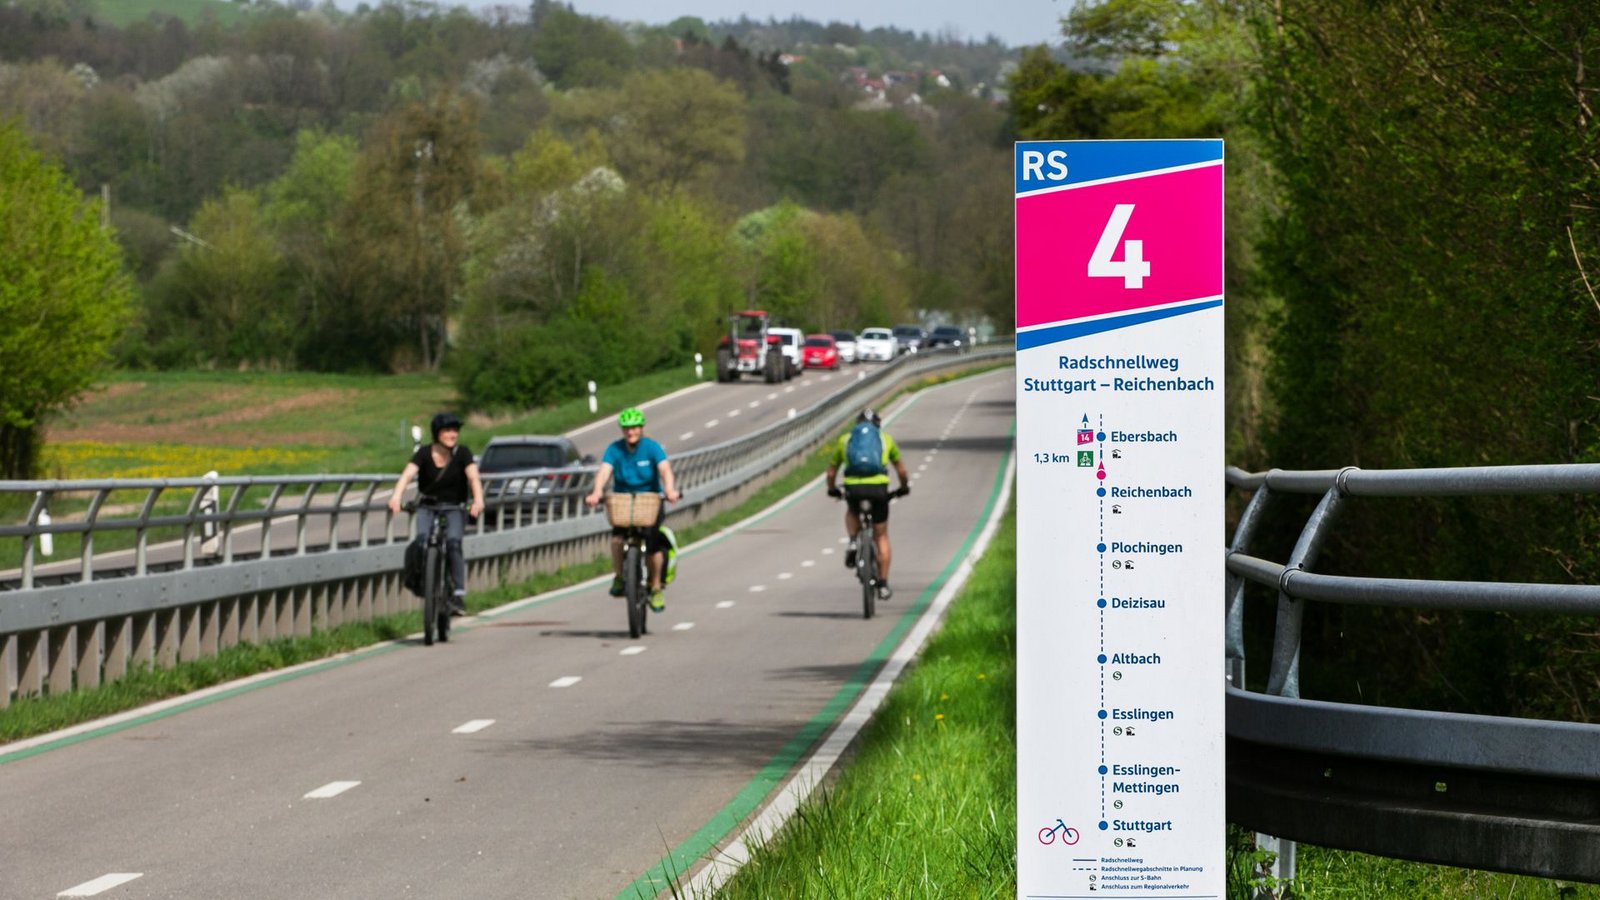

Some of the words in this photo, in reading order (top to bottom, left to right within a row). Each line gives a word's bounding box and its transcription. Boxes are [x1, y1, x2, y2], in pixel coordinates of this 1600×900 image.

[1023, 150, 1068, 181] RS
[1088, 204, 1150, 288] 4
[1059, 355, 1179, 372] Radschnellweg
[1024, 378, 1096, 394] Stuttgart
[1114, 377, 1214, 391] Reichenbach
[1081, 433, 1090, 442] 14
[1111, 431, 1177, 442] Ebersbach
[1034, 453, 1049, 464] 1,3
[1052, 453, 1070, 463] km
[1111, 486, 1192, 497] Reichenbach
[1111, 542, 1183, 555] Plochingen
[1112, 597, 1165, 608] Deizisau
[1111, 653, 1161, 664] Altbach
[1112, 708, 1174, 721] Esslingen
[1112, 764, 1180, 777] Esslingen-
[1113, 782, 1180, 795] Mettingen
[1113, 819, 1172, 833] Stuttgart
